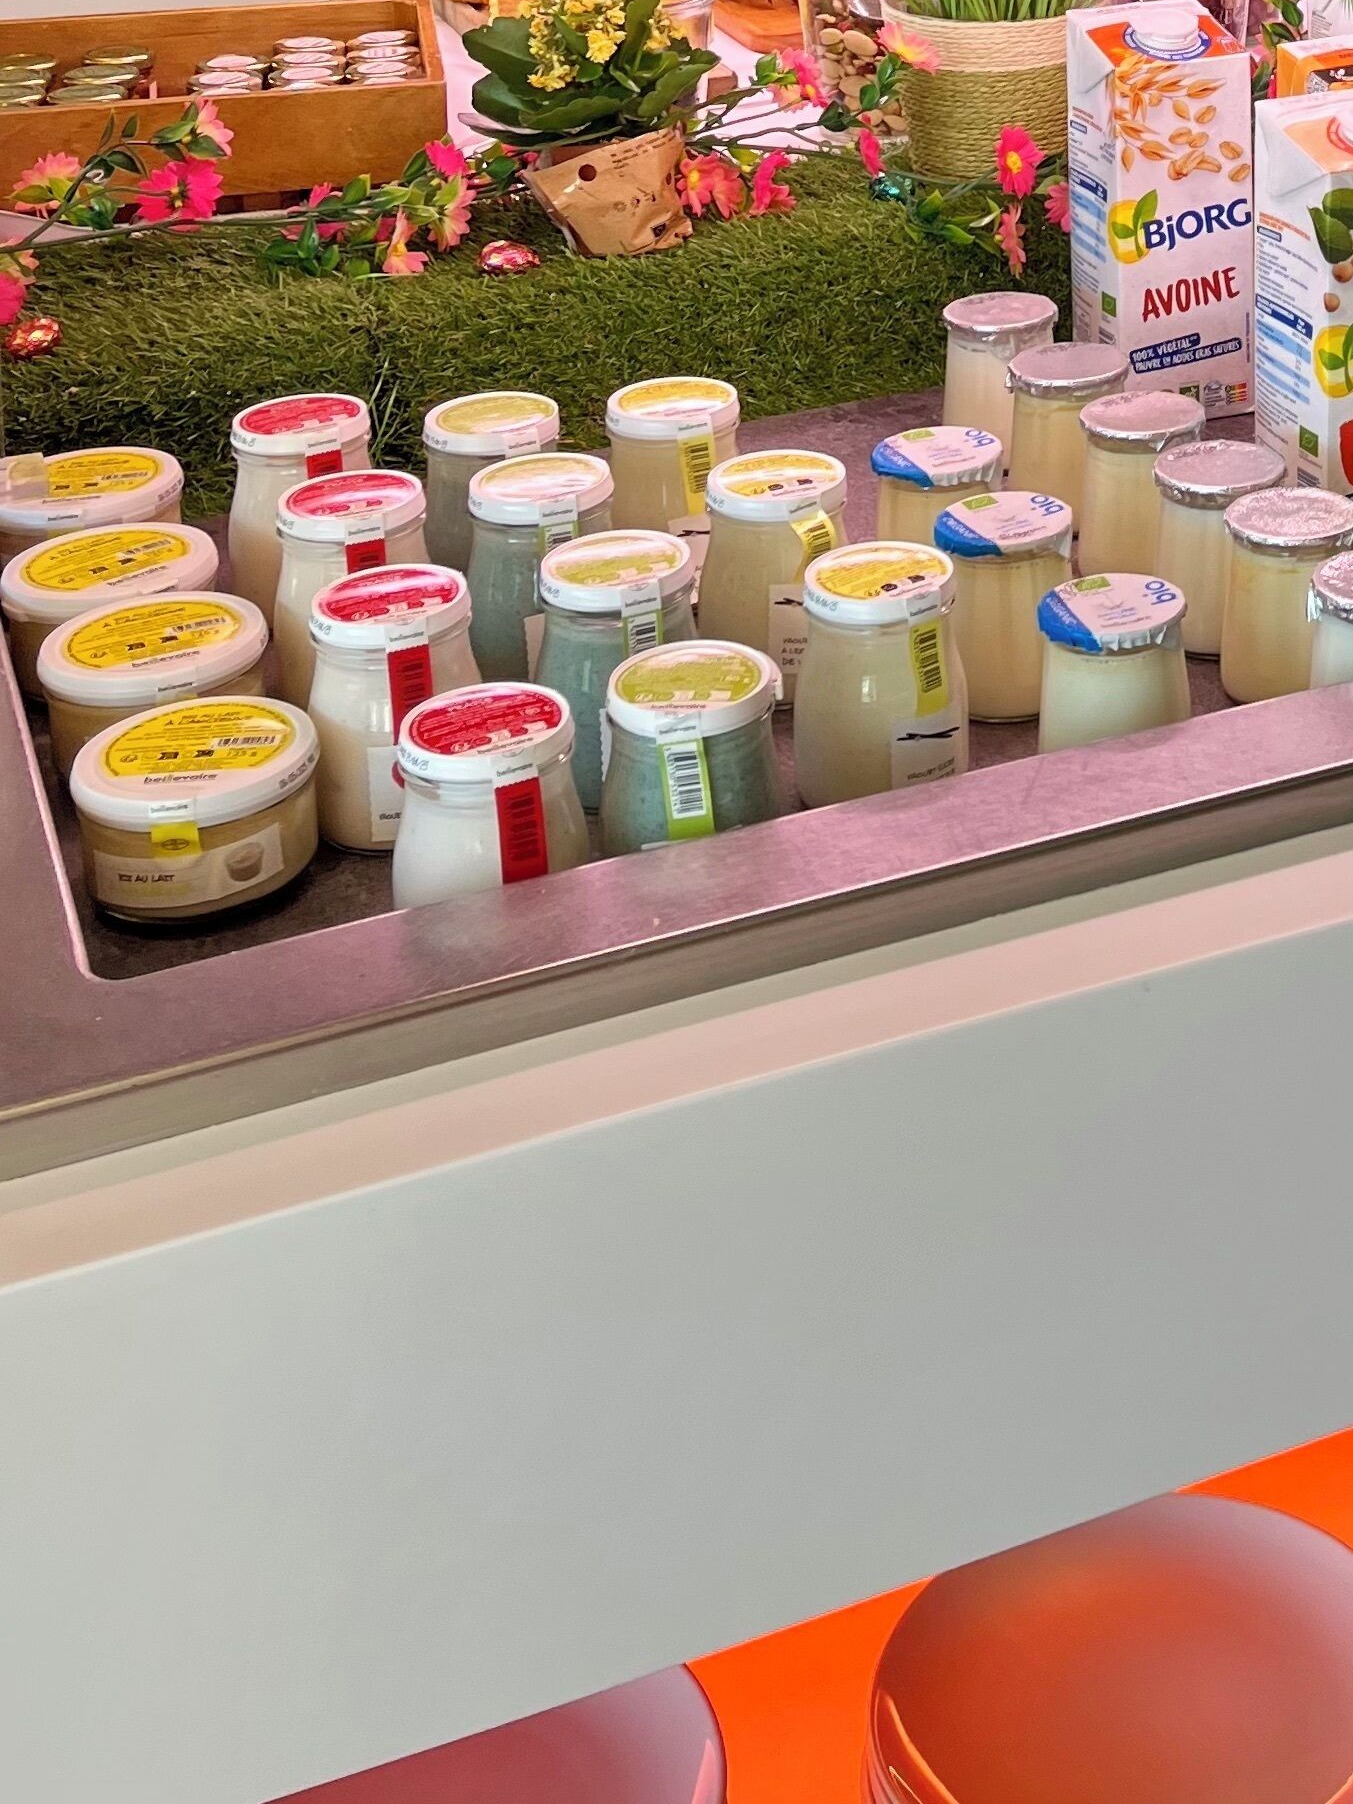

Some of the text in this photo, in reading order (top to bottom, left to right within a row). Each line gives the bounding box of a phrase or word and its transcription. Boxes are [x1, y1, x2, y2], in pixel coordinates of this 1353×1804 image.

[1142, 266, 1241, 323] AVOINE
[965, 428, 997, 448] bio
[1030, 494, 1065, 518] bio
[1144, 580, 1177, 606] bio
